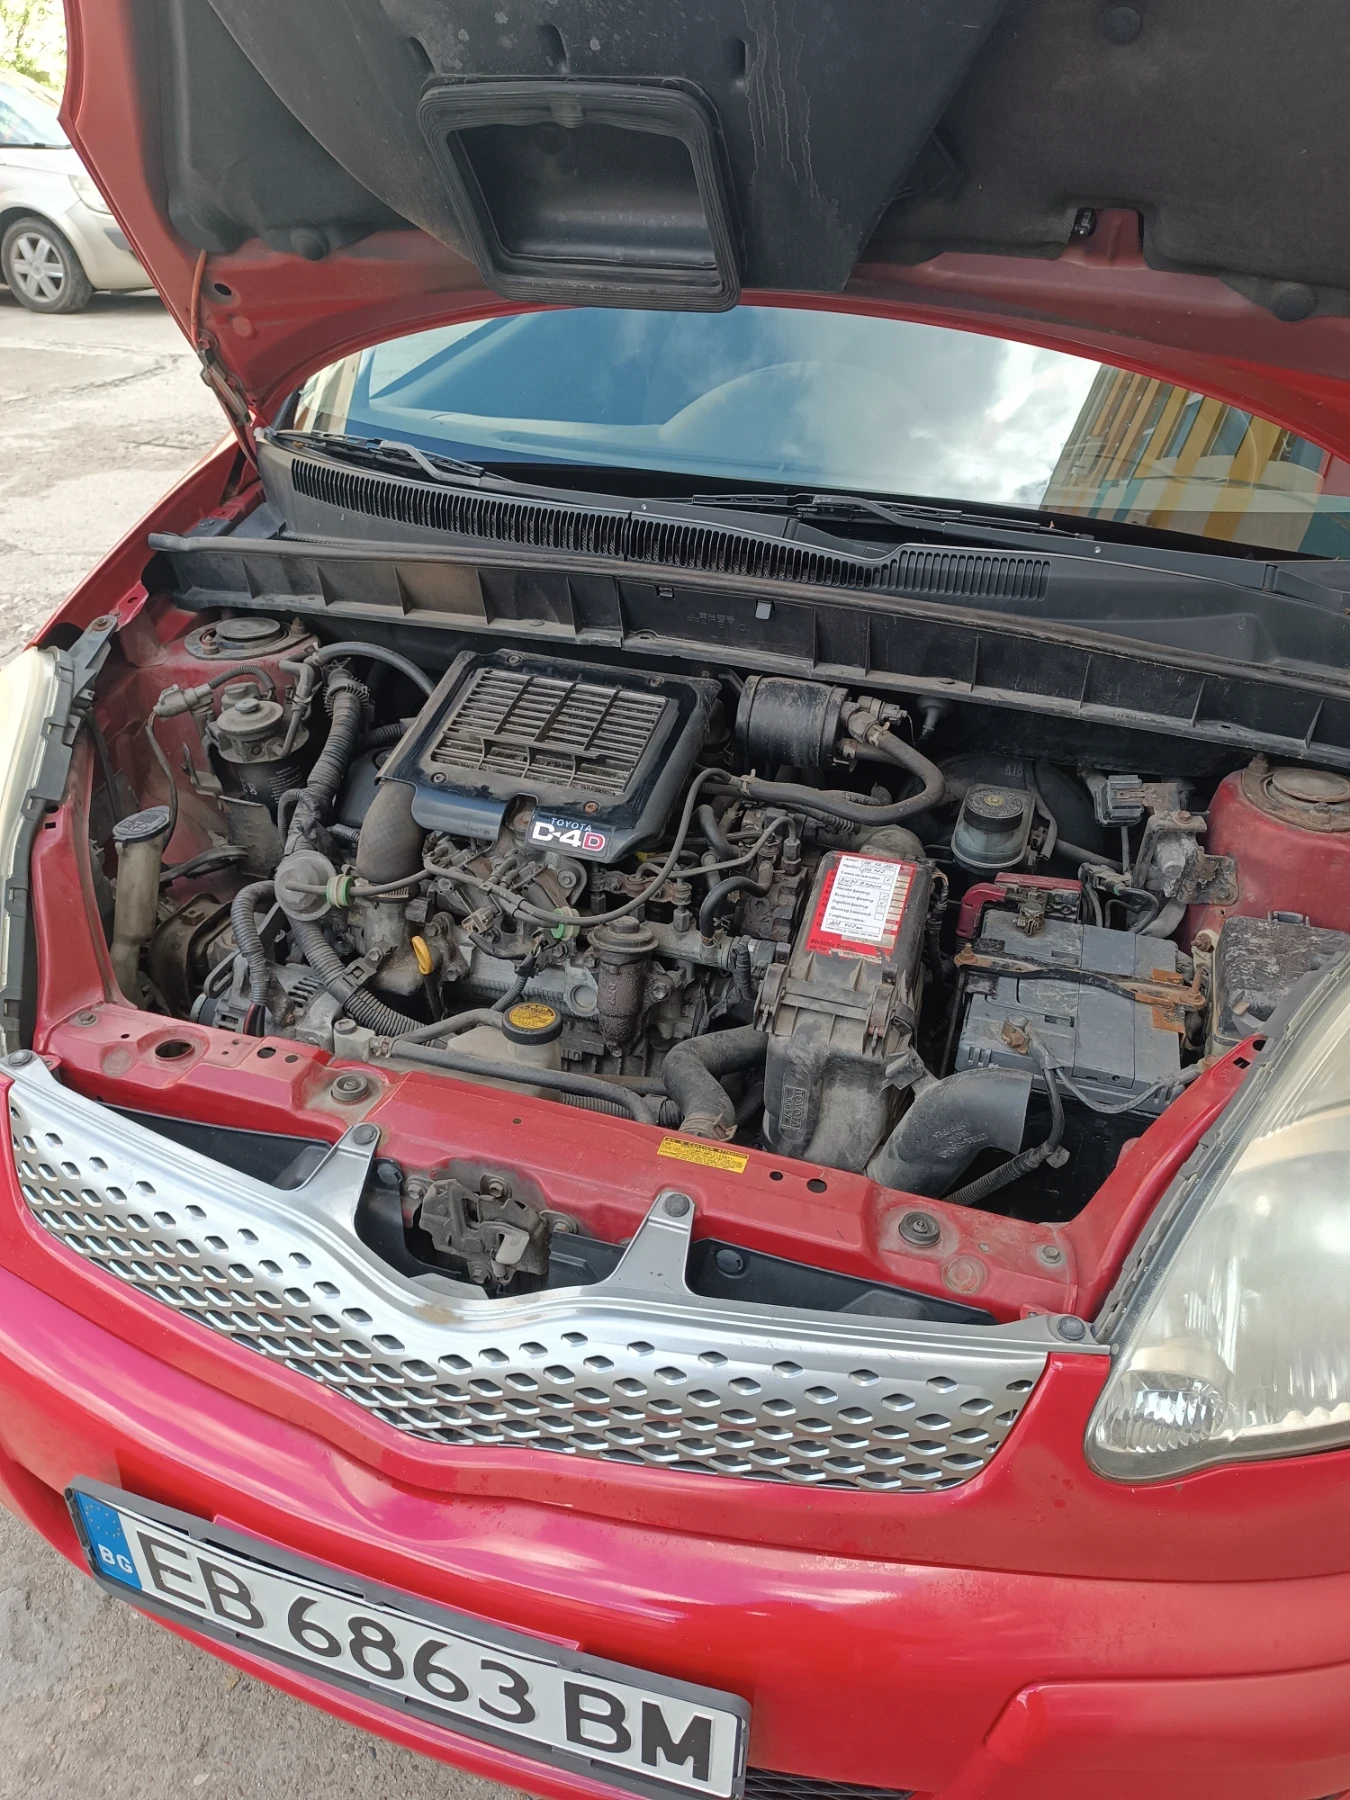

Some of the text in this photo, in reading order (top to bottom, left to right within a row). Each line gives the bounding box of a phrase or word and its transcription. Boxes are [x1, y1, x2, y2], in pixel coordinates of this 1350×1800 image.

[532, 821, 605, 851] D-4D
[551, 817, 592, 832] TOYOTA
[98, 1543, 133, 1574] BG
[136, 1530, 713, 1782] EB 6863 BM
